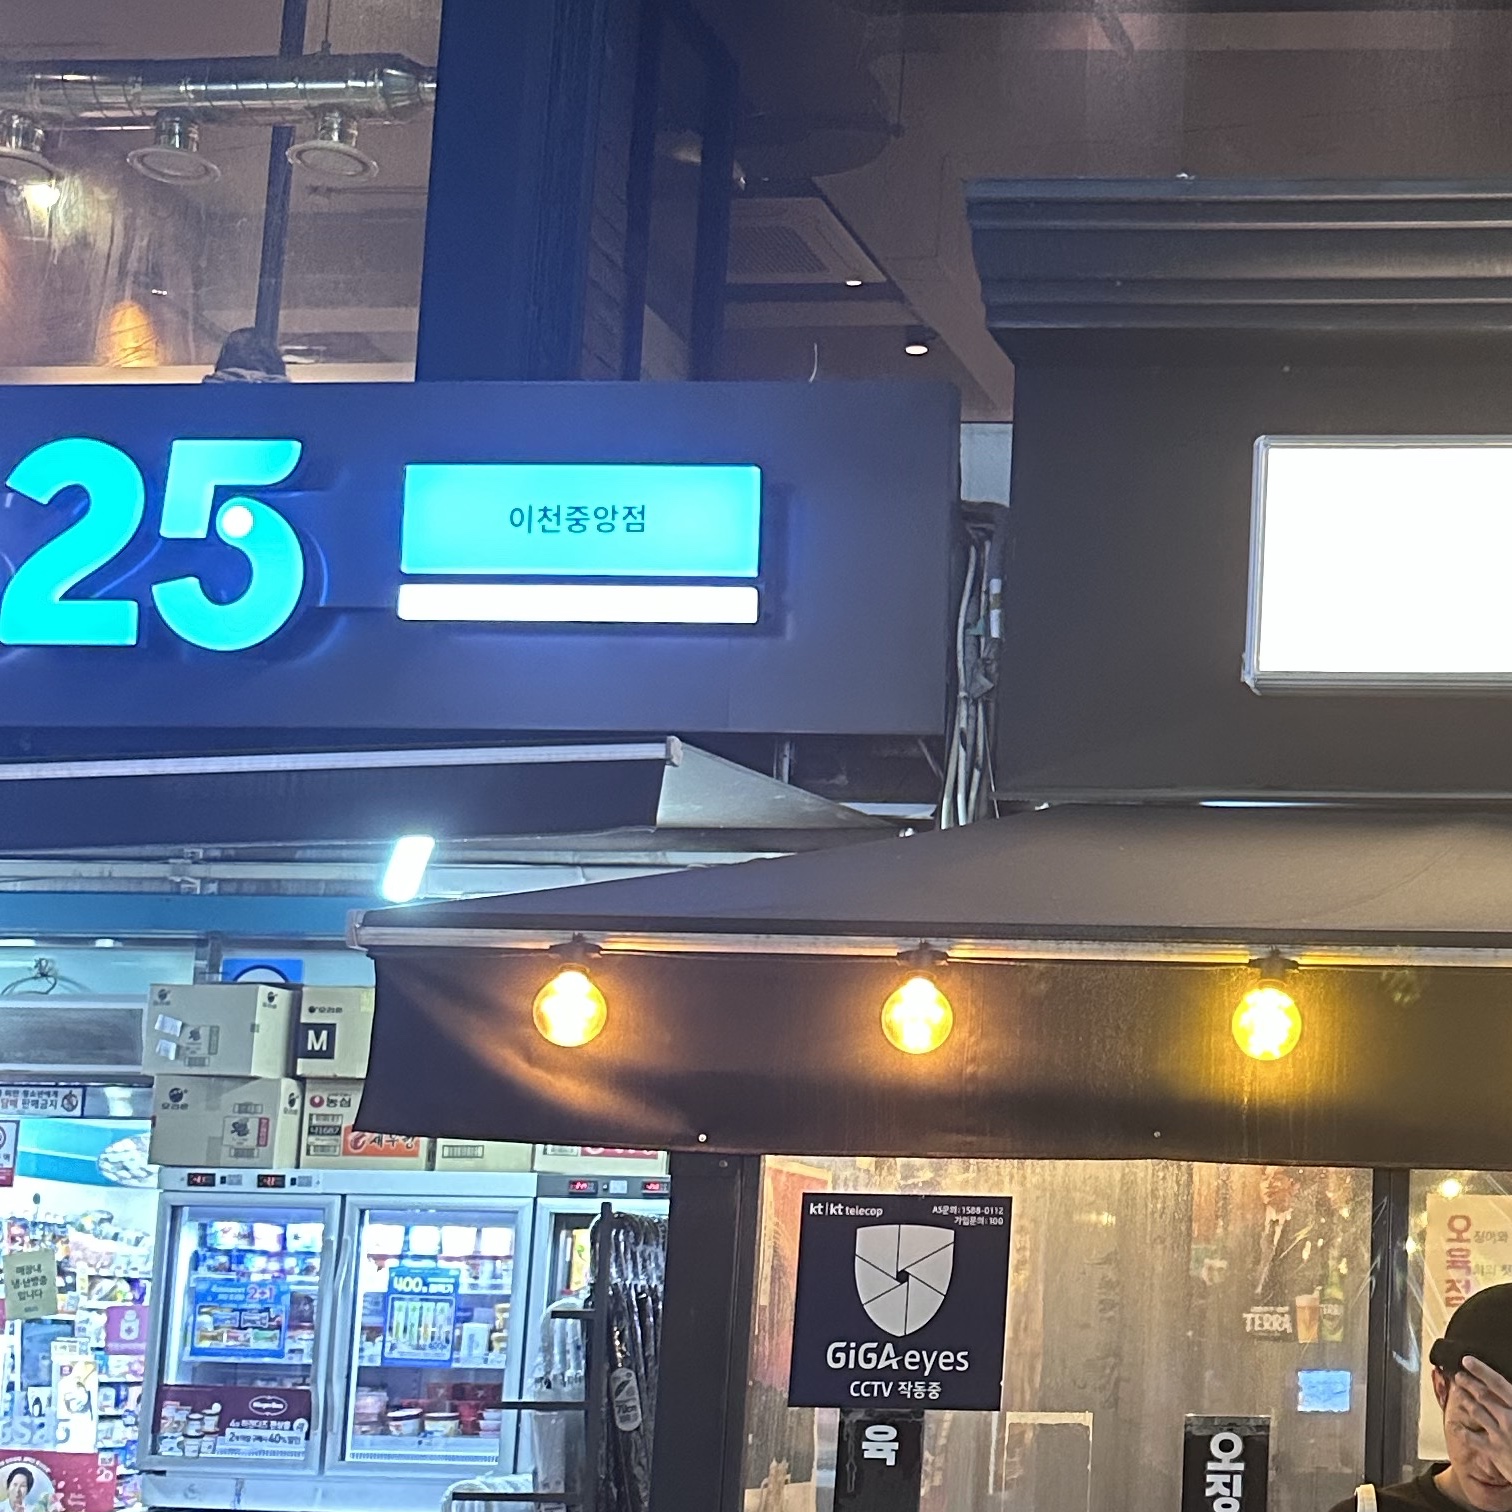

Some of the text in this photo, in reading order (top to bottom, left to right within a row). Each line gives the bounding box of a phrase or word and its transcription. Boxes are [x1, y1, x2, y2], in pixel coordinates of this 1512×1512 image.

[509, 504, 647, 535] 이천중앙점
[0, 437, 304, 652] 25
[307, 1030, 328, 1051] M
[845, 1206, 883, 1218] telecop
[1242, 1313, 1292, 1333] TERRA
[850, 1381, 942, 1399] CCTV 작동중
